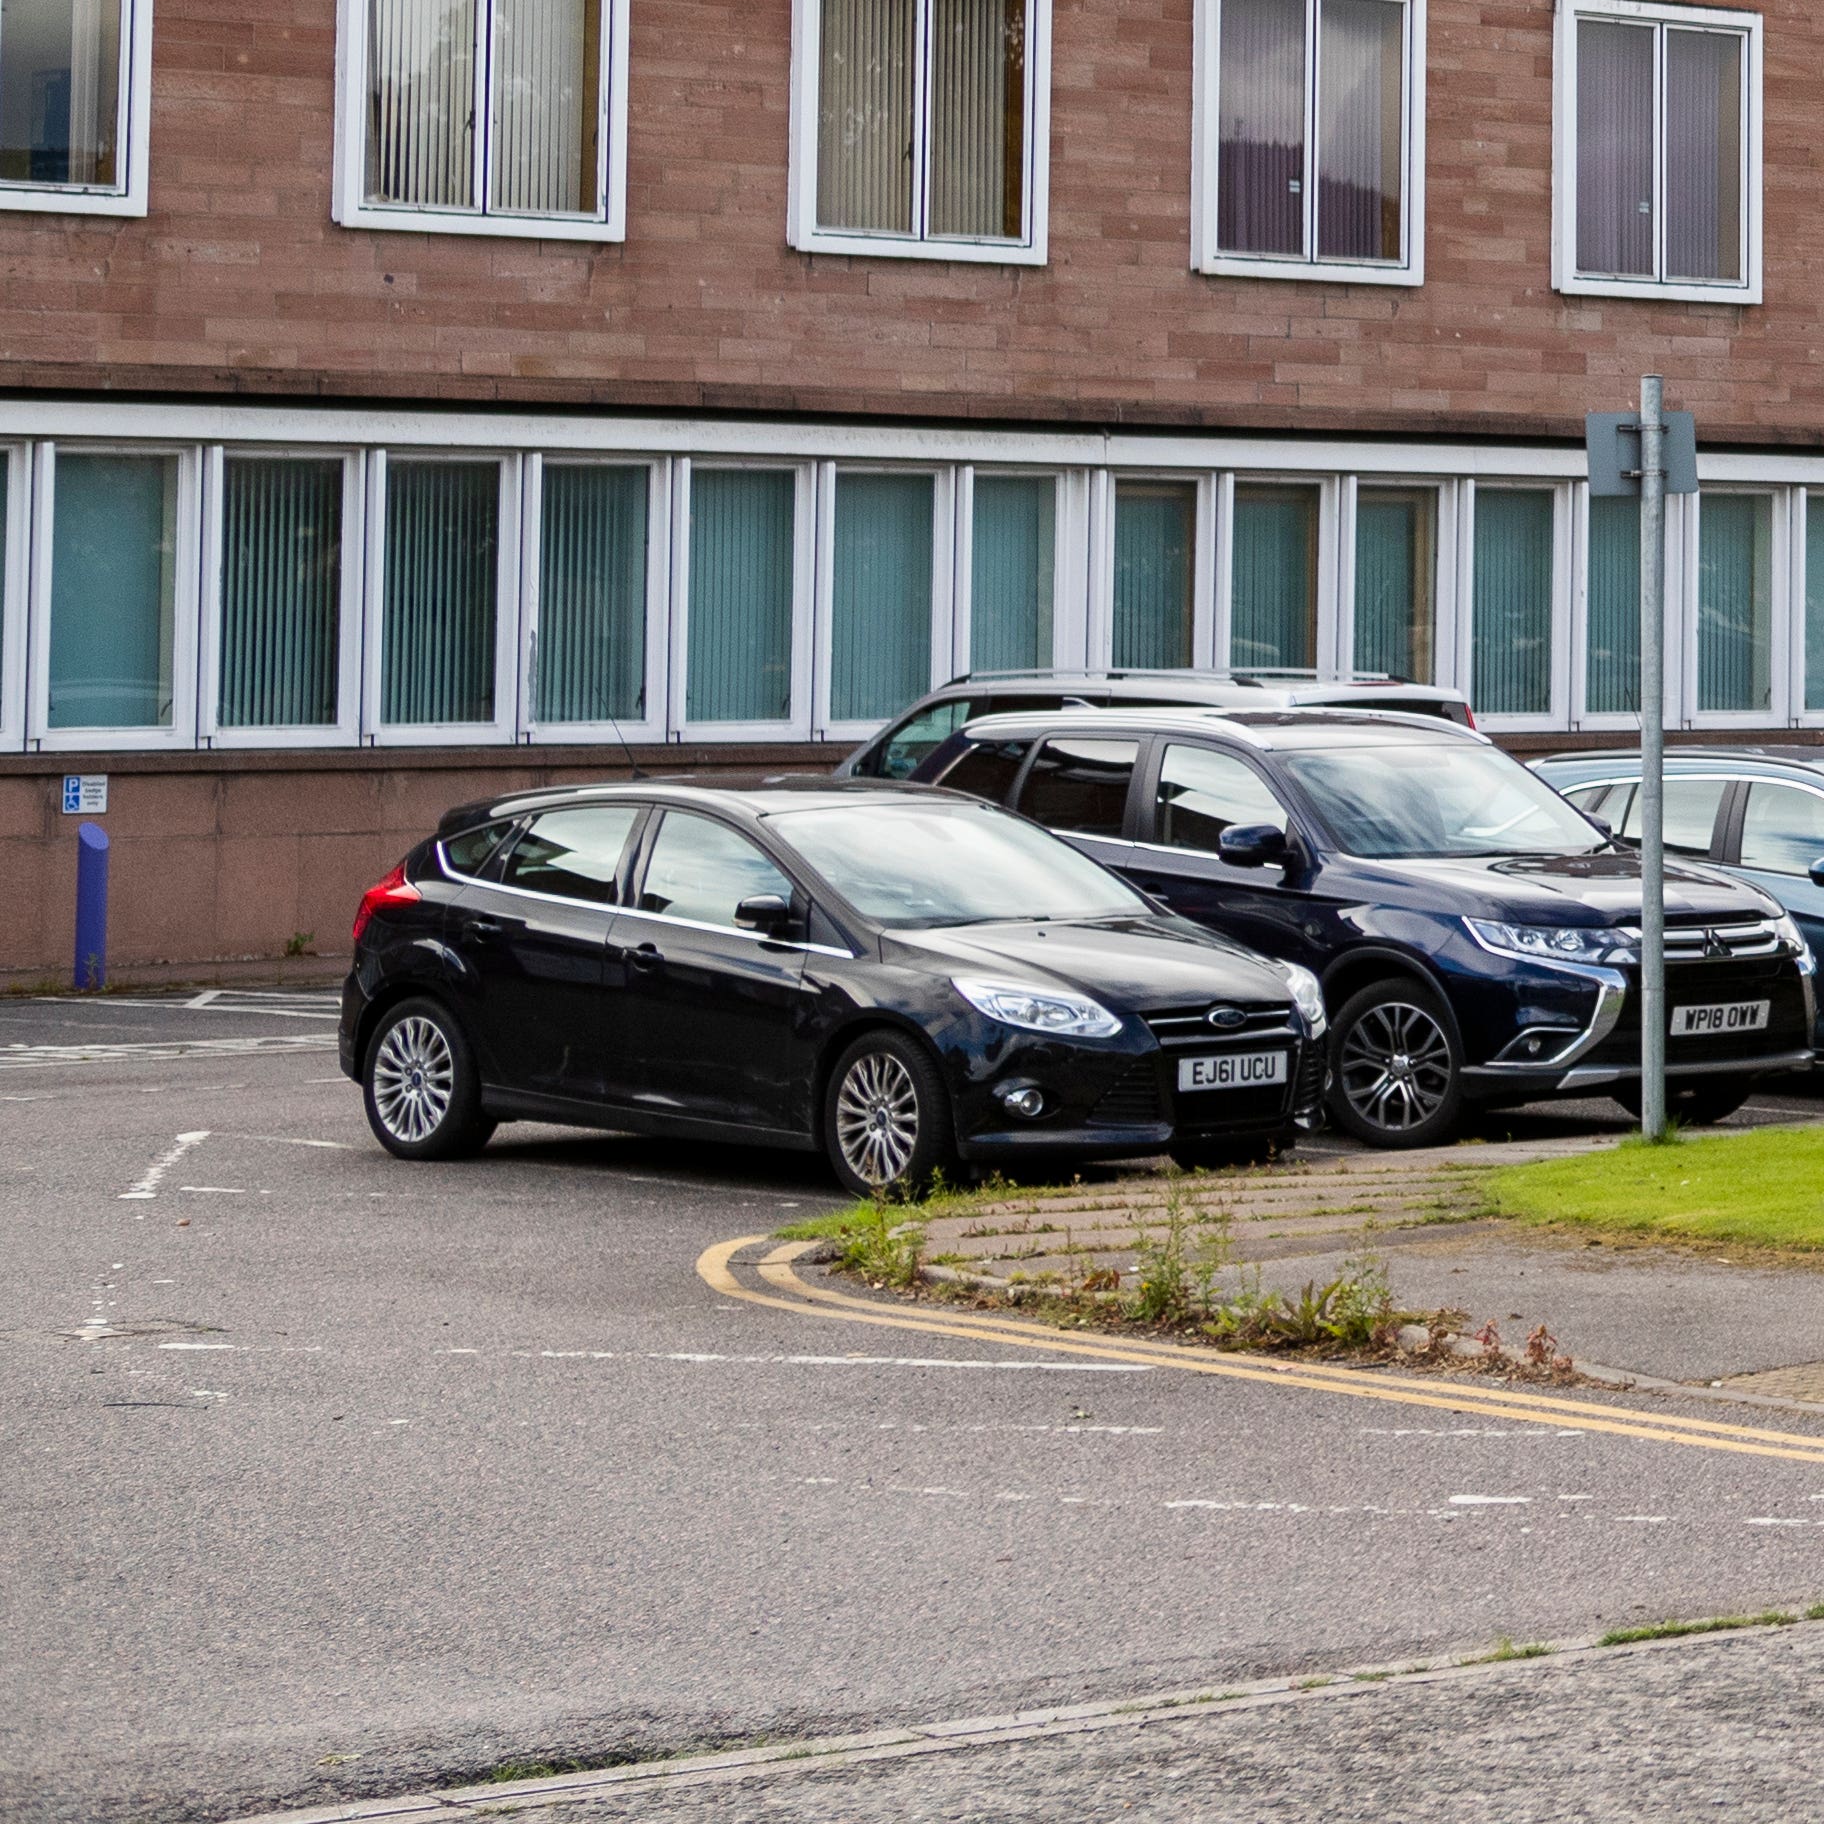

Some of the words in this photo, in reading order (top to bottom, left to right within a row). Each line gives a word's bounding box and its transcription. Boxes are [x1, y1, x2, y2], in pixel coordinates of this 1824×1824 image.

[1685, 1009, 1724, 1031] WP18
[1192, 1060, 1235, 1085] EJ61
[1240, 1056, 1276, 1081] UCU
